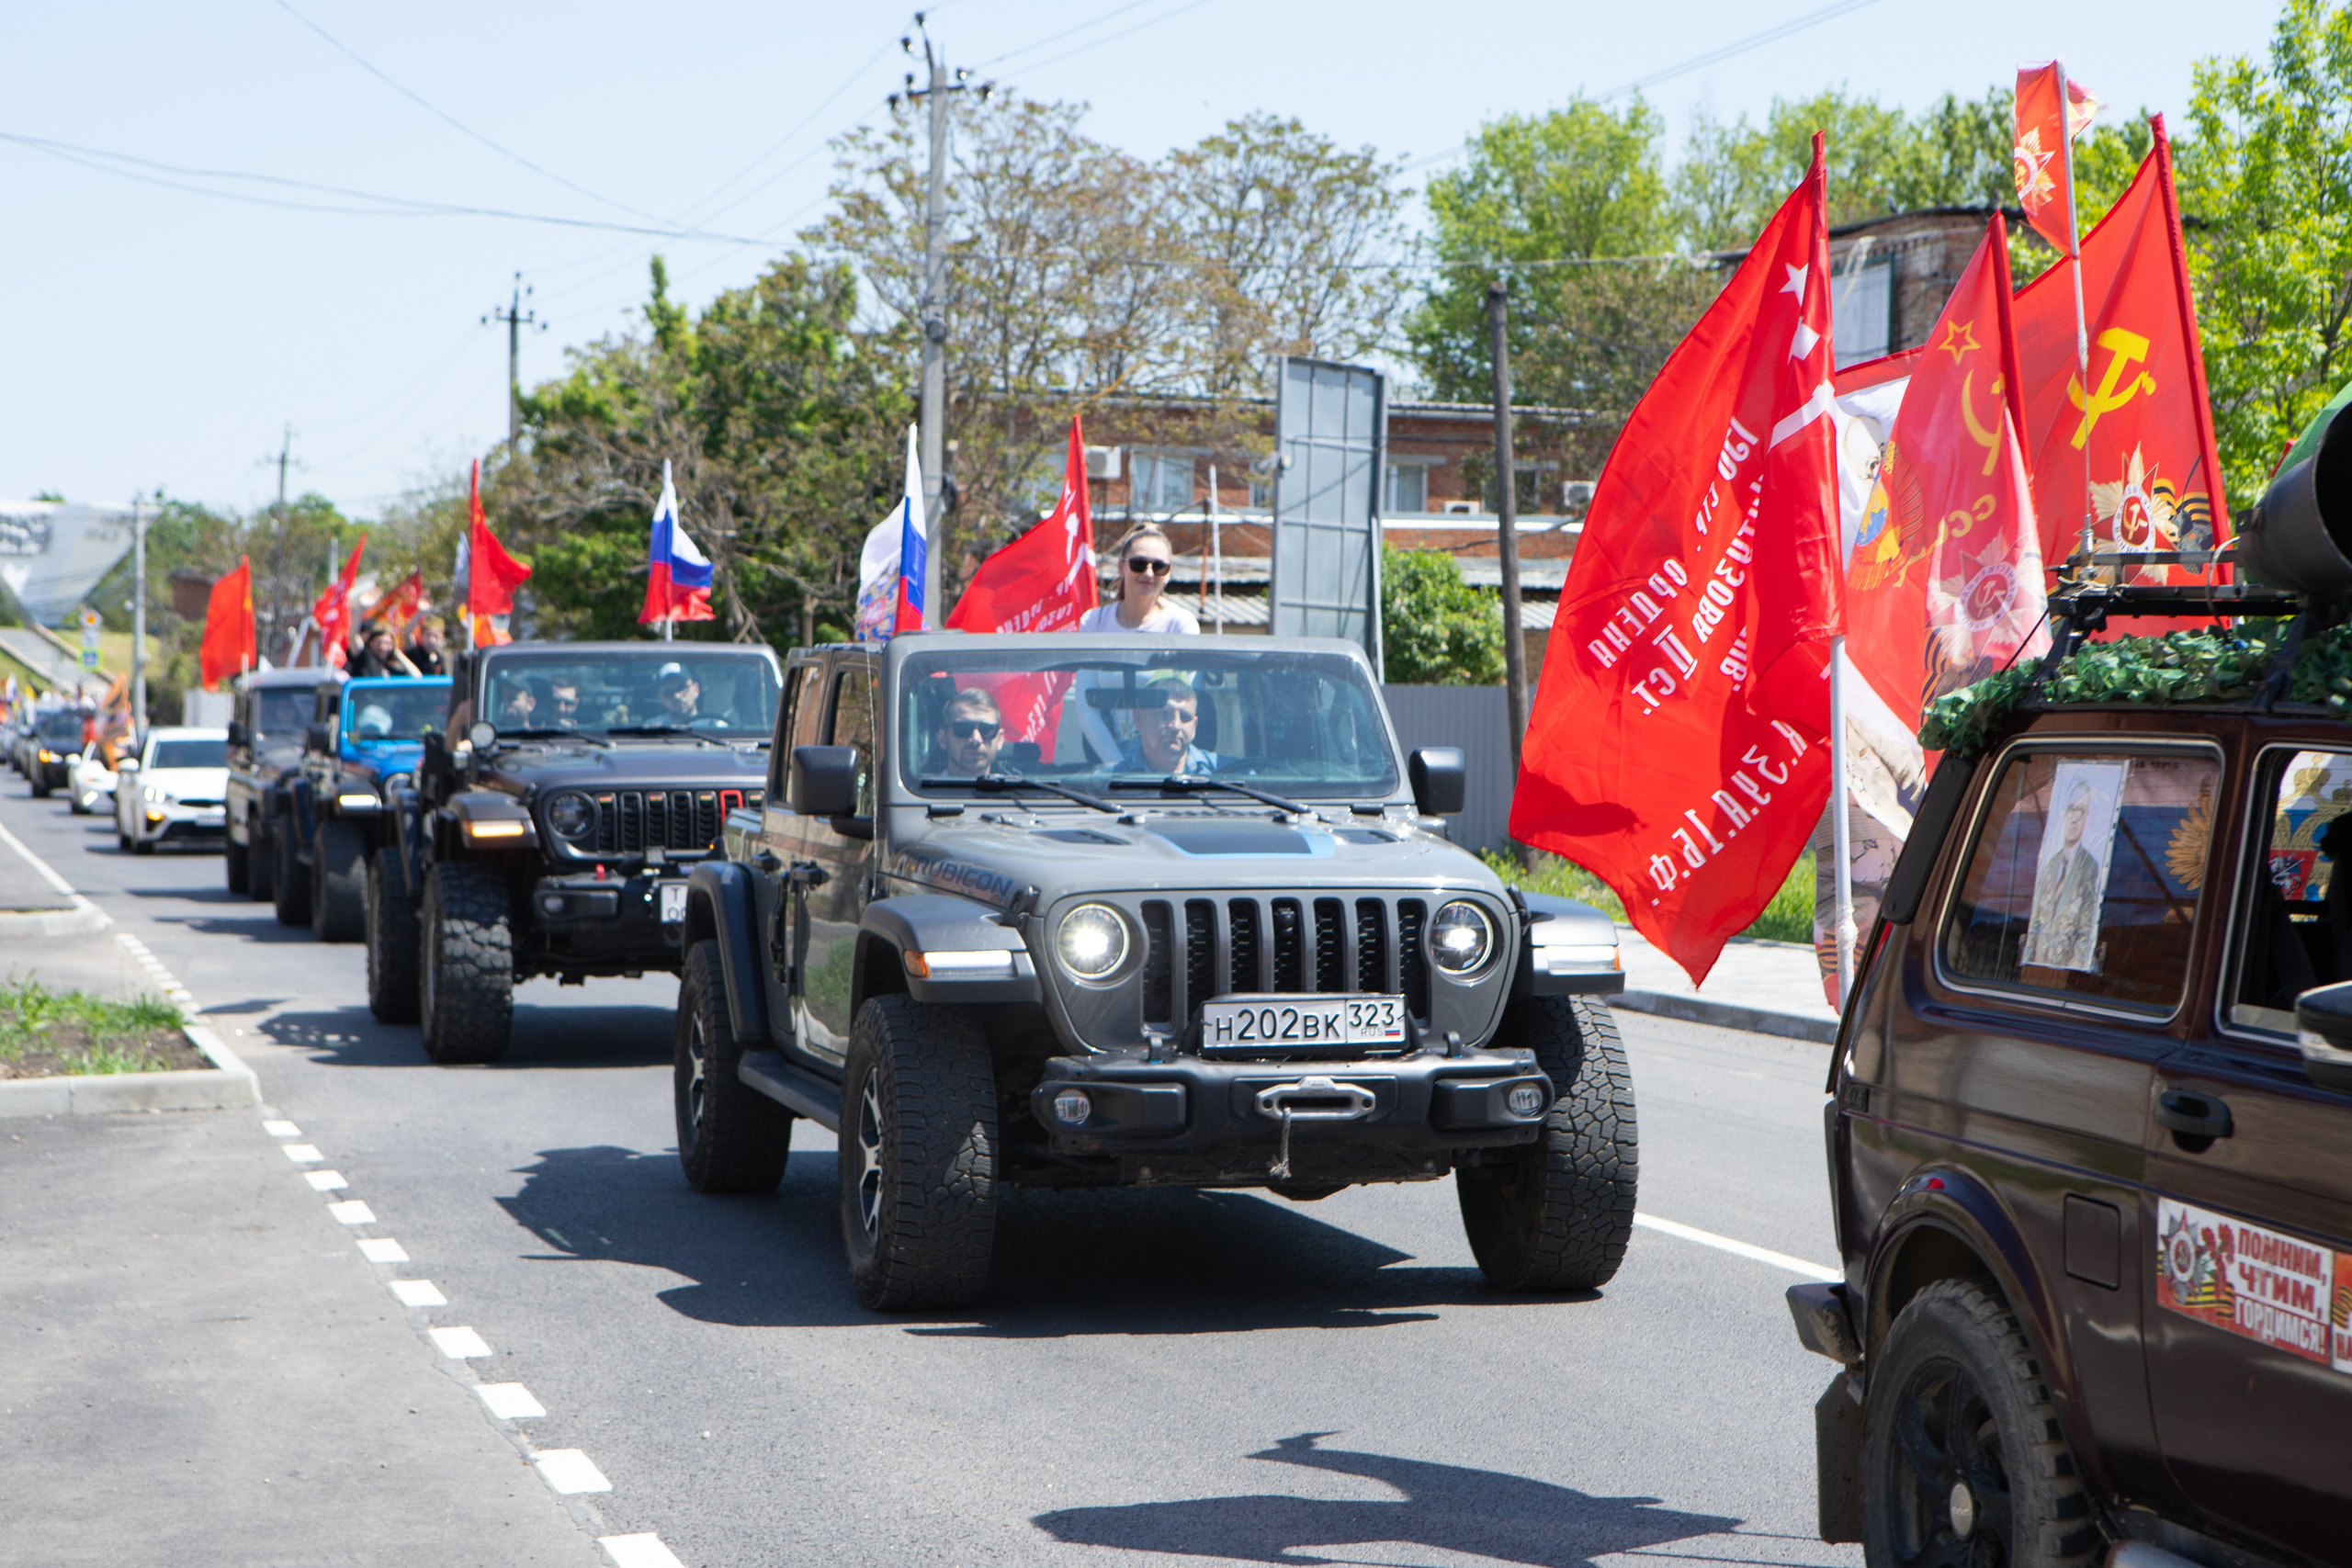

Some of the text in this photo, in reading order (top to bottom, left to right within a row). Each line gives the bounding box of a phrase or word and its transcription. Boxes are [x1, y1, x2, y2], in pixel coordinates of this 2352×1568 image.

[915, 855, 1013, 897] RUBICON
[1216, 1001, 1396, 1042] Н202ВК 323
[1361, 1026, 1384, 1037] RUS
[2238, 1227, 2327, 1287] ПОМНИМ,
[2239, 1261, 2323, 1321] ЧТИМ,
[2234, 1296, 2325, 1356] ГОРДИМСЯ!
